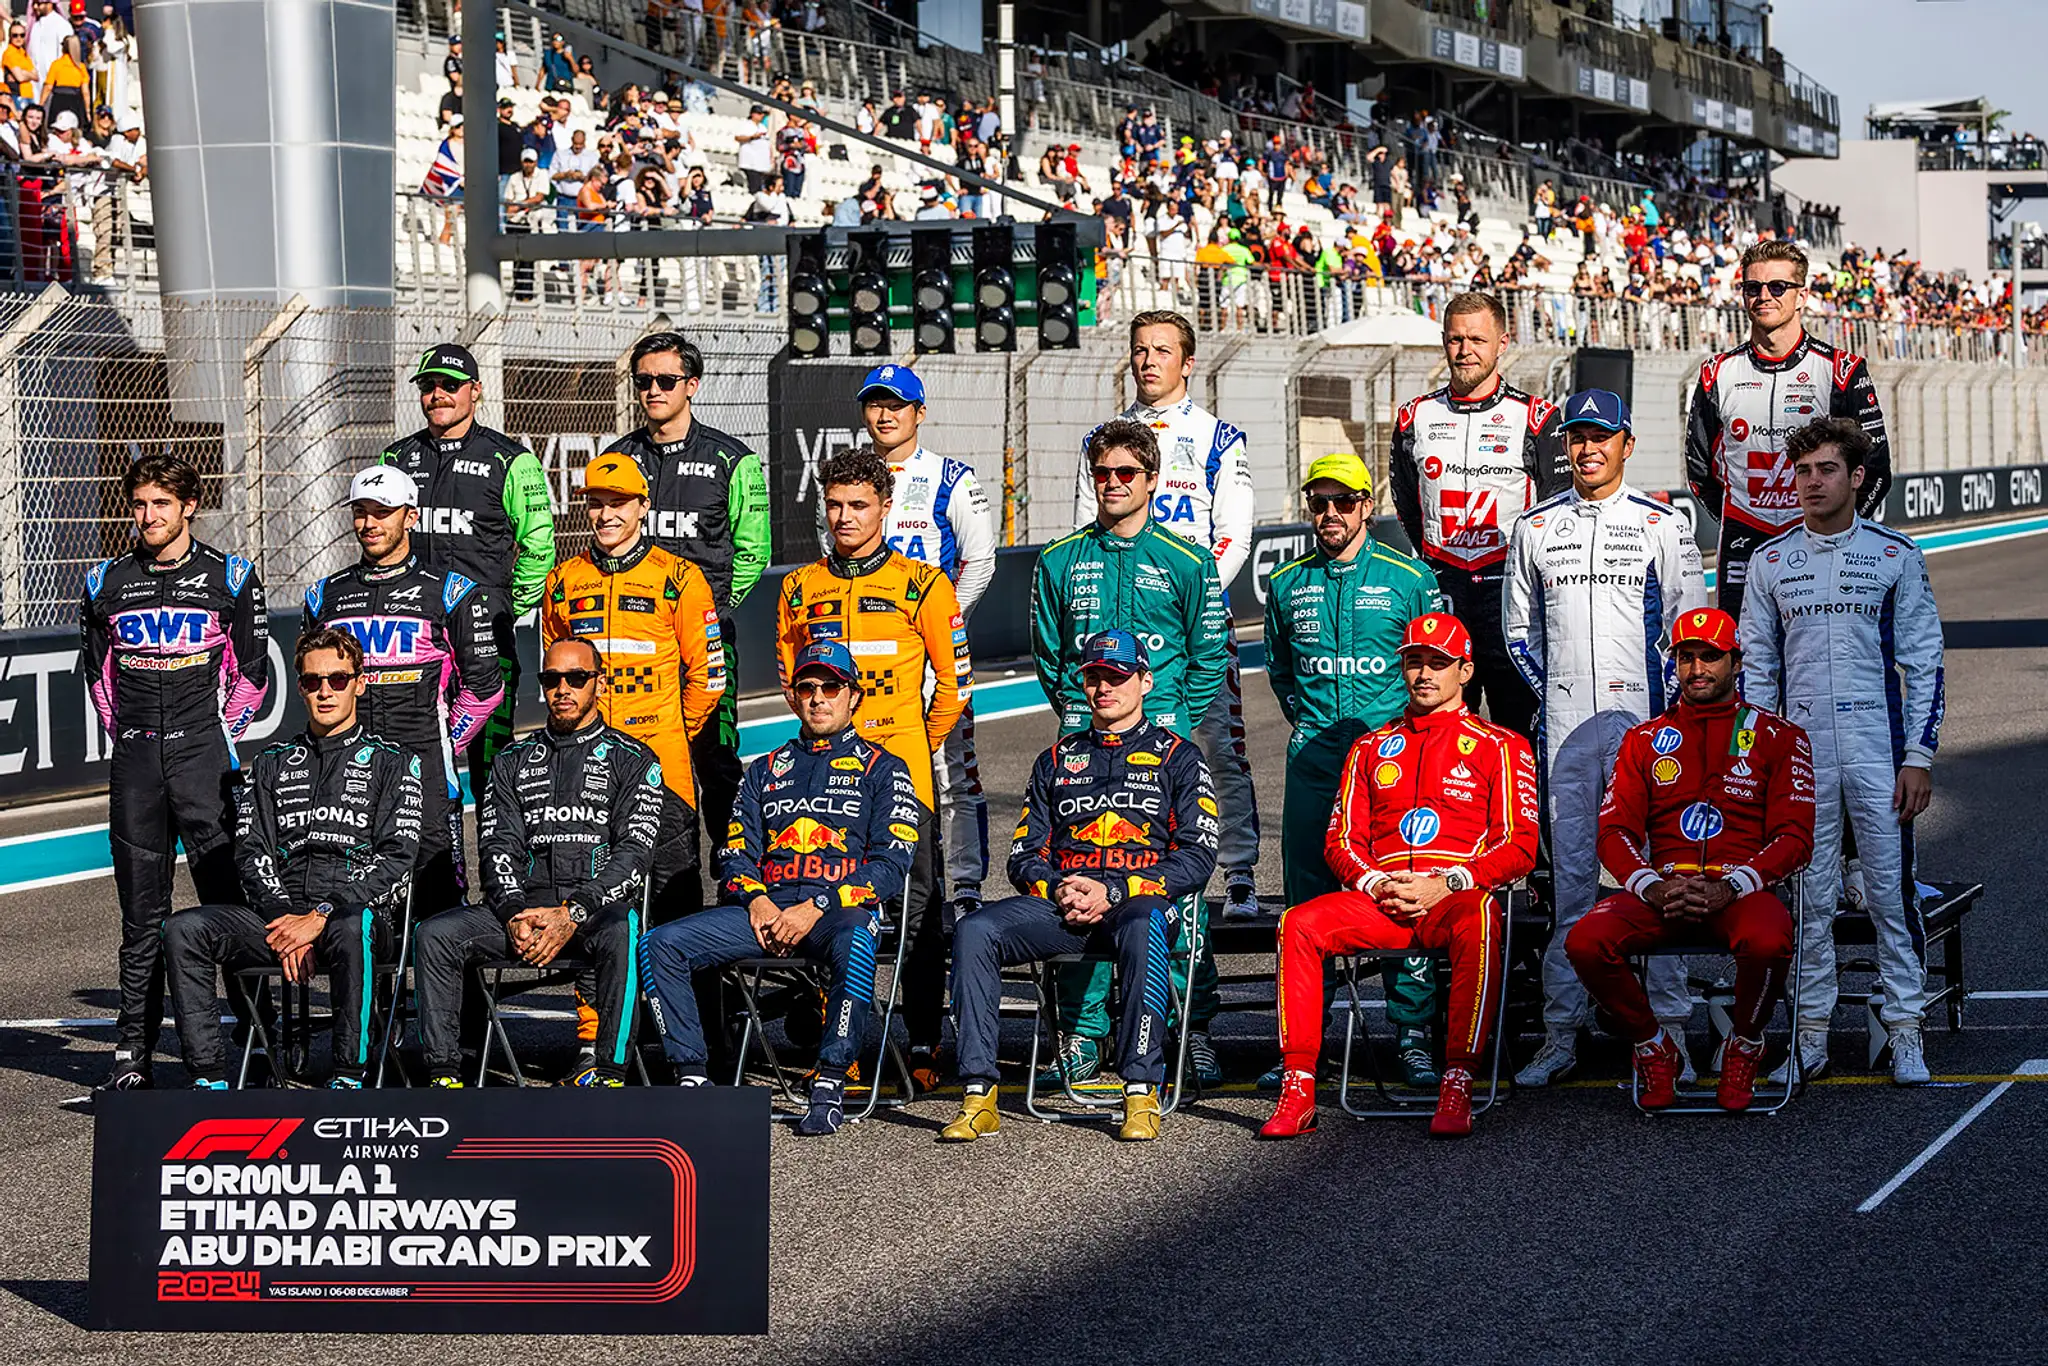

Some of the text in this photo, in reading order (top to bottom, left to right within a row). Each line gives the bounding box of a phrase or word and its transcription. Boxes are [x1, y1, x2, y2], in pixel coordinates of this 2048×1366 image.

[442, 356, 464, 368] KICK
[452, 459, 491, 478] KICK
[677, 461, 716, 478] KICK
[1445, 463, 1513, 478] MoneyGram
[1166, 480, 1197, 491] HUGO
[897, 521, 928, 530] HUGO
[1605, 524, 1645, 534] WILLIAMS
[1546, 542, 1582, 553] KOMATSU
[1604, 544, 1643, 552] DURACELL
[1546, 557, 1582, 568] Stephens
[1842, 552, 1881, 562] WILLIAMS
[1135, 576, 1170, 588] aramco
[1556, 574, 1644, 586] MYPROTEIN
[1780, 574, 1815, 585] KOMATSU
[572, 581, 603, 592] Android
[810, 587, 841, 600] Android
[1779, 588, 1814, 600] Stephens
[1355, 598, 1392, 607] aramco
[1293, 608, 1318, 619] BOSS
[1792, 602, 1880, 616] MYPROTEIN
[118, 609, 210, 646] BWT
[128, 655, 168, 670] Castrol
[1300, 656, 1387, 675] aramco
[231, 706, 255, 735] BWT
[876, 717, 895, 727] LN4
[451, 713, 476, 743] BWT
[164, 731, 185, 740] JACK
[290, 770, 310, 780] UBS
[344, 768, 372, 780] INEOS
[531, 766, 548, 777] UBS
[829, 775, 861, 787] BYBIT
[1055, 777, 1082, 786] Mobil
[1442, 777, 1477, 788] Santander
[1723, 774, 1758, 787] Santander
[825, 788, 862, 797] HONDA
[1124, 782, 1161, 793] HONDA
[638, 803, 661, 815] IWC
[763, 796, 862, 819] ORACLE
[1058, 793, 1160, 816] ORACLE
[1060, 848, 1160, 870] Red Bull
[763, 854, 856, 884] Red Bull
[652, 997, 666, 1036] sparco
[838, 999, 850, 1037] sparco
[1137, 1014, 1152, 1055] sparco
[313, 1117, 450, 1138] ETIHAD
[343, 1144, 420, 1159] AIRWAYS
[161, 1164, 398, 1196] FORMULA 1
[160, 1200, 516, 1230] ETIHAD AIRWAYS
[158, 1235, 652, 1267] ABU DHABI GRAND PRIX
[158, 1271, 260, 1301] 2024
[269, 1287, 408, 1297] YAS ISLAND 06-08 DECEMBER
